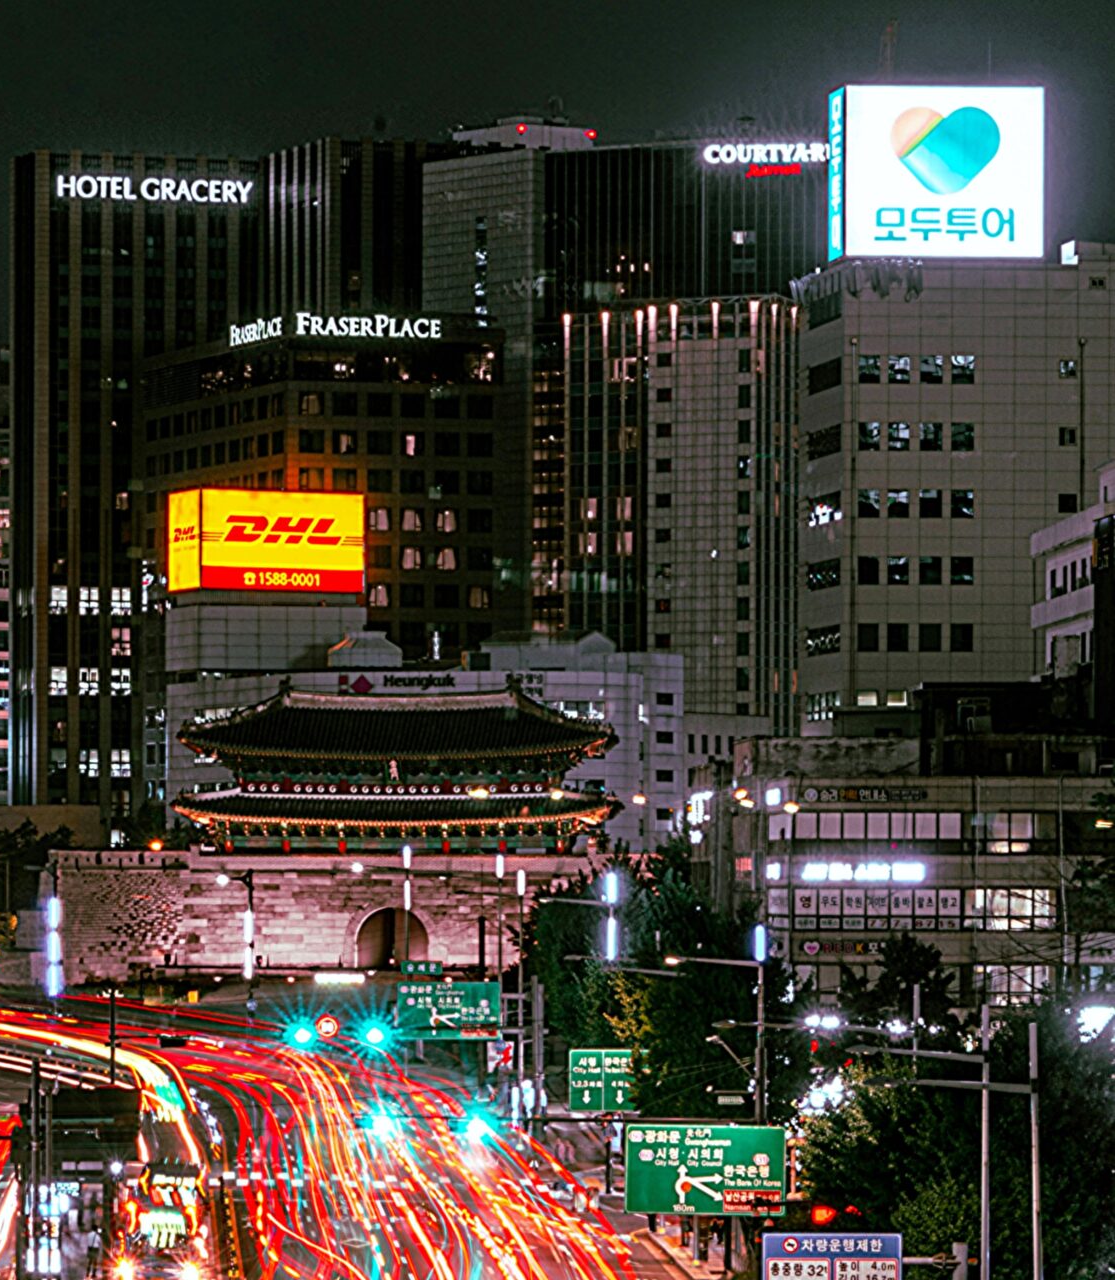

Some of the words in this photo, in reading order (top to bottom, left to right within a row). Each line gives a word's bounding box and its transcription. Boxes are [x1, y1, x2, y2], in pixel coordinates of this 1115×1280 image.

[703, 143, 830, 163] COURTYAR
[56, 174, 137, 200] HOTEL
[140, 177, 253, 203] GRACERY
[874, 207, 1015, 241] 모두투어
[174, 526, 196, 542] DHL
[224, 515, 341, 546] DHL
[258, 571, 321, 587] 1588-0001
[384, 674, 456, 690] Heungkuk
[644, 1130, 681, 1144] 광화문
[724, 1164, 770, 1178] 한국은행
[801, 1238, 883, 1252] 차량운행제한
[770, 1262, 803, 1276] 총중량
[838, 1262, 860, 1271] 높이
